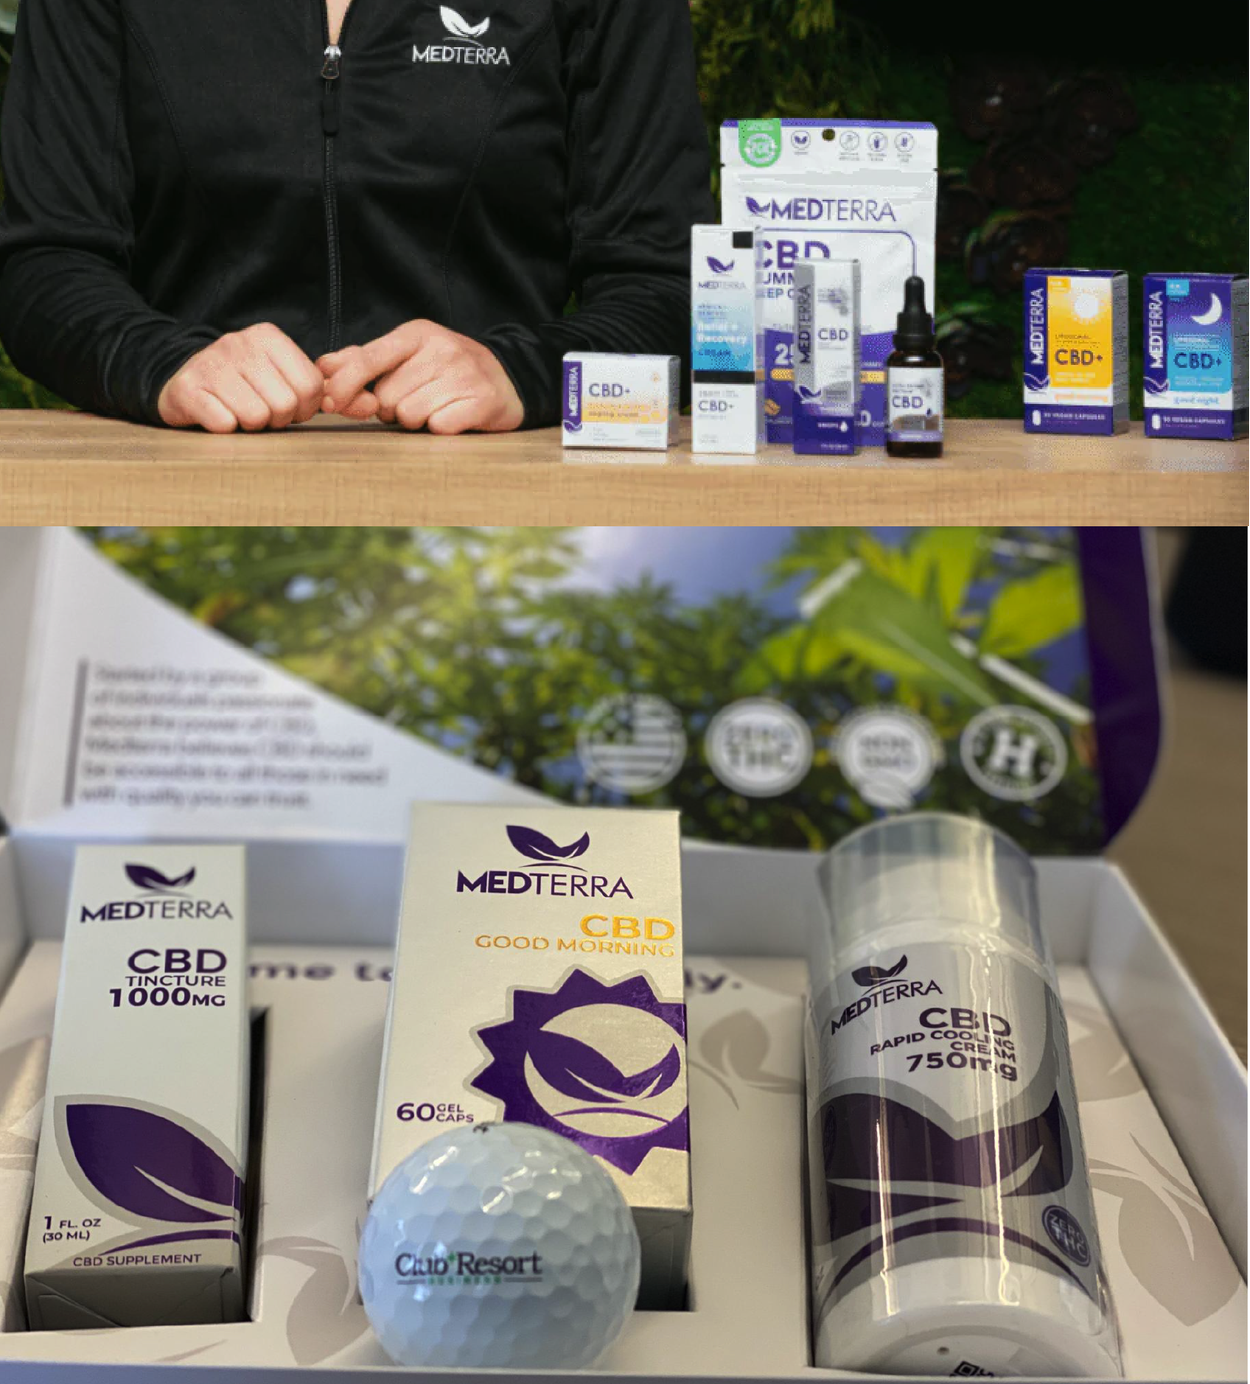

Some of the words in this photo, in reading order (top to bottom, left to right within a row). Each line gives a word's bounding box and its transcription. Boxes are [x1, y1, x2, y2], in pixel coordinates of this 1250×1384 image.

[412, 44, 511, 66] MEDTERRA
[771, 198, 897, 222] MEDTERRA
[798, 284, 811, 364] MEDTERRA
[818, 328, 848, 341] CBD
[1030, 288, 1044, 365] MEDTERRA
[1149, 291, 1164, 369] MEDTERRA
[1055, 349, 1103, 366] CBD+
[1173, 352, 1222, 369] CBD+
[589, 383, 631, 398] CBD+
[698, 400, 734, 412] CBD+
[892, 396, 923, 409] CBD
[456, 869, 634, 900] MEDTERRA
[80, 900, 234, 923] MEDTERRA
[579, 913, 676, 940] CBD
[474, 934, 549, 951] GOOD
[557, 937, 676, 958] MORNING
[127, 948, 227, 975] CBD
[125, 975, 226, 988] TINCTURE
[109, 987, 226, 1008] 1000MG
[831, 979, 944, 1036] MEDTERRA
[919, 1007, 1012, 1037] CBD
[870, 1032, 925, 1056] RAPID
[930, 1030, 1015, 1051] COOLING
[950, 1041, 1016, 1063] CREAM
[906, 1052, 1018, 1081] 750mg
[396, 1102, 436, 1123] 60
[435, 1112, 475, 1124] CAPS
[436, 1103, 465, 1114] GEL
[44, 1215, 53, 1230] 1
[81, 1217, 101, 1228] OZ
[42, 1230, 64, 1243] (30
[66, 1229, 91, 1242] ML)
[73, 1256, 103, 1267] CBD
[106, 1253, 202, 1267] SUPPLEMENT
[395, 1252, 449, 1276] Club
[457, 1251, 543, 1276] Resort
